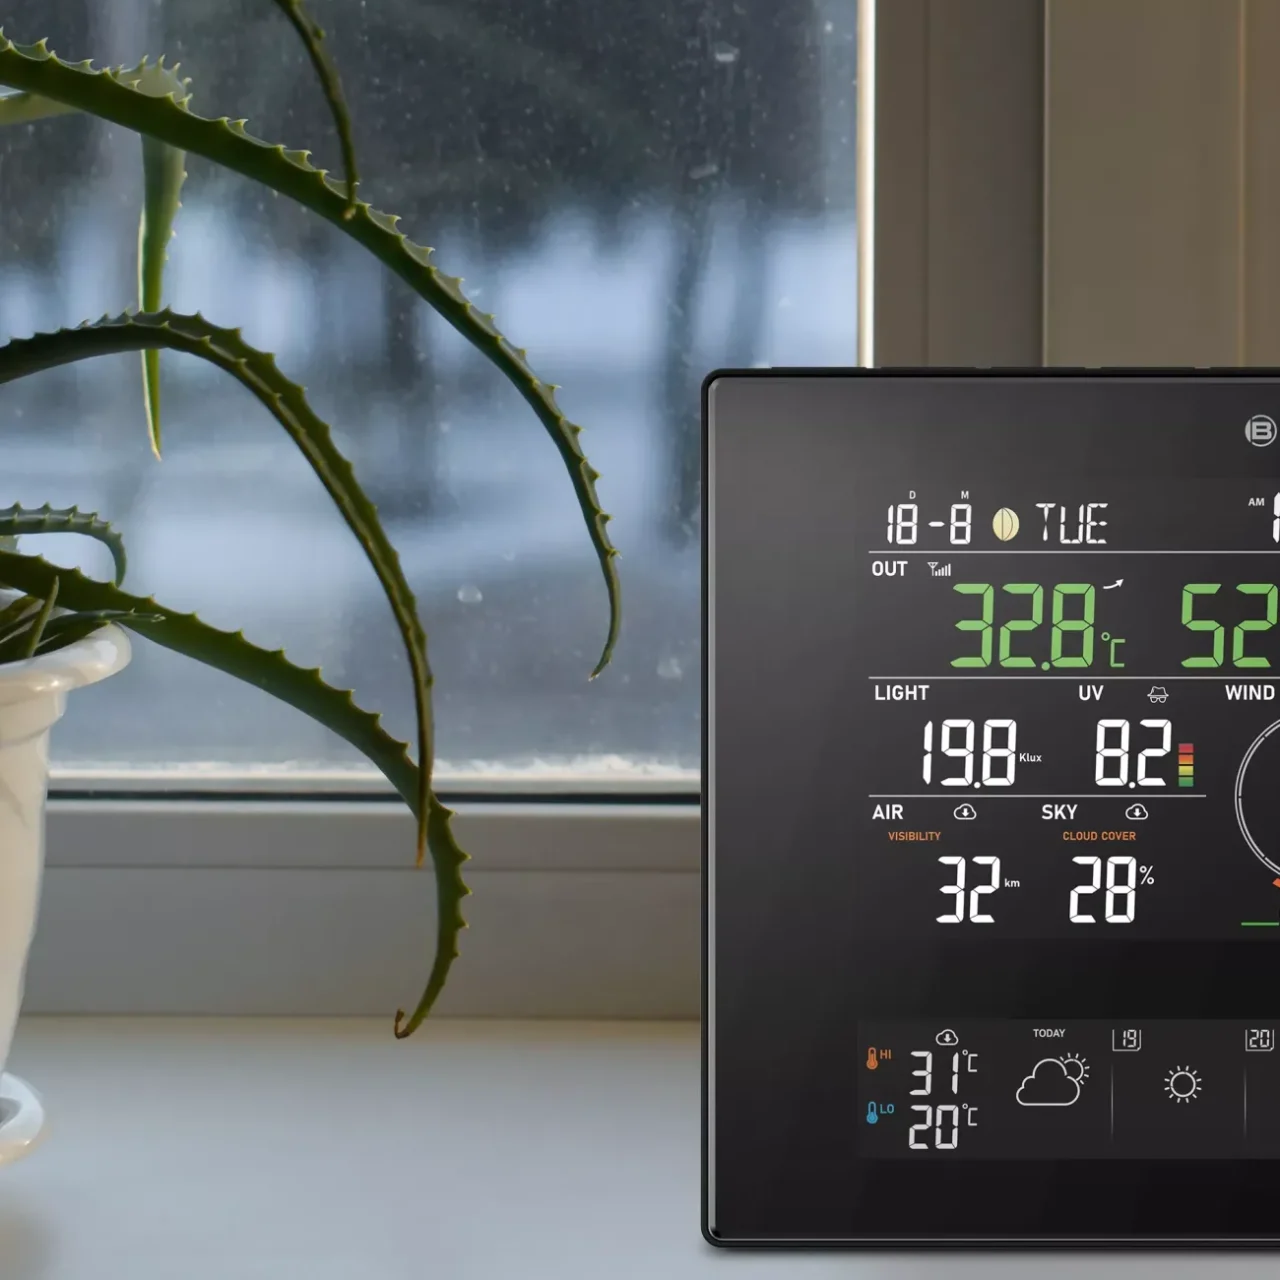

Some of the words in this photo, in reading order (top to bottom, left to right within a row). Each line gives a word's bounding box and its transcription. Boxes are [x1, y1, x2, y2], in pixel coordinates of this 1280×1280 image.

[908, 490, 917, 500] D
[960, 490, 970, 500] M
[1247, 497, 1265, 507] AM
[1035, 502, 1109, 545] TUE
[871, 560, 909, 577] OUT
[1180, 583, 1279, 668] 52
[874, 684, 930, 701] LIGHT
[1078, 684, 1104, 701] UV
[1224, 684, 1275, 701] WIND
[922, 718, 1017, 789] 19.8
[1094, 718, 1172, 789] 8.2
[871, 803, 904, 820] AIR
[1041, 803, 1078, 820] SKY
[887, 831, 941, 841] VISIBILITY
[1062, 831, 1098, 841] CLOUD
[1100, 831, 1137, 841] COVER
[935, 855, 1001, 924] 32
[1004, 877, 1021, 888] km
[1069, 855, 1137, 924] 28
[1032, 1028, 1066, 1038] TODAY
[1122, 1029, 1137, 1048] 19
[1249, 1029, 1270, 1048] 20
[879, 1049, 892, 1060] HI
[909, 1050, 960, 1096] 31
[879, 1103, 895, 1115] LO
[908, 1104, 959, 1150] 20
